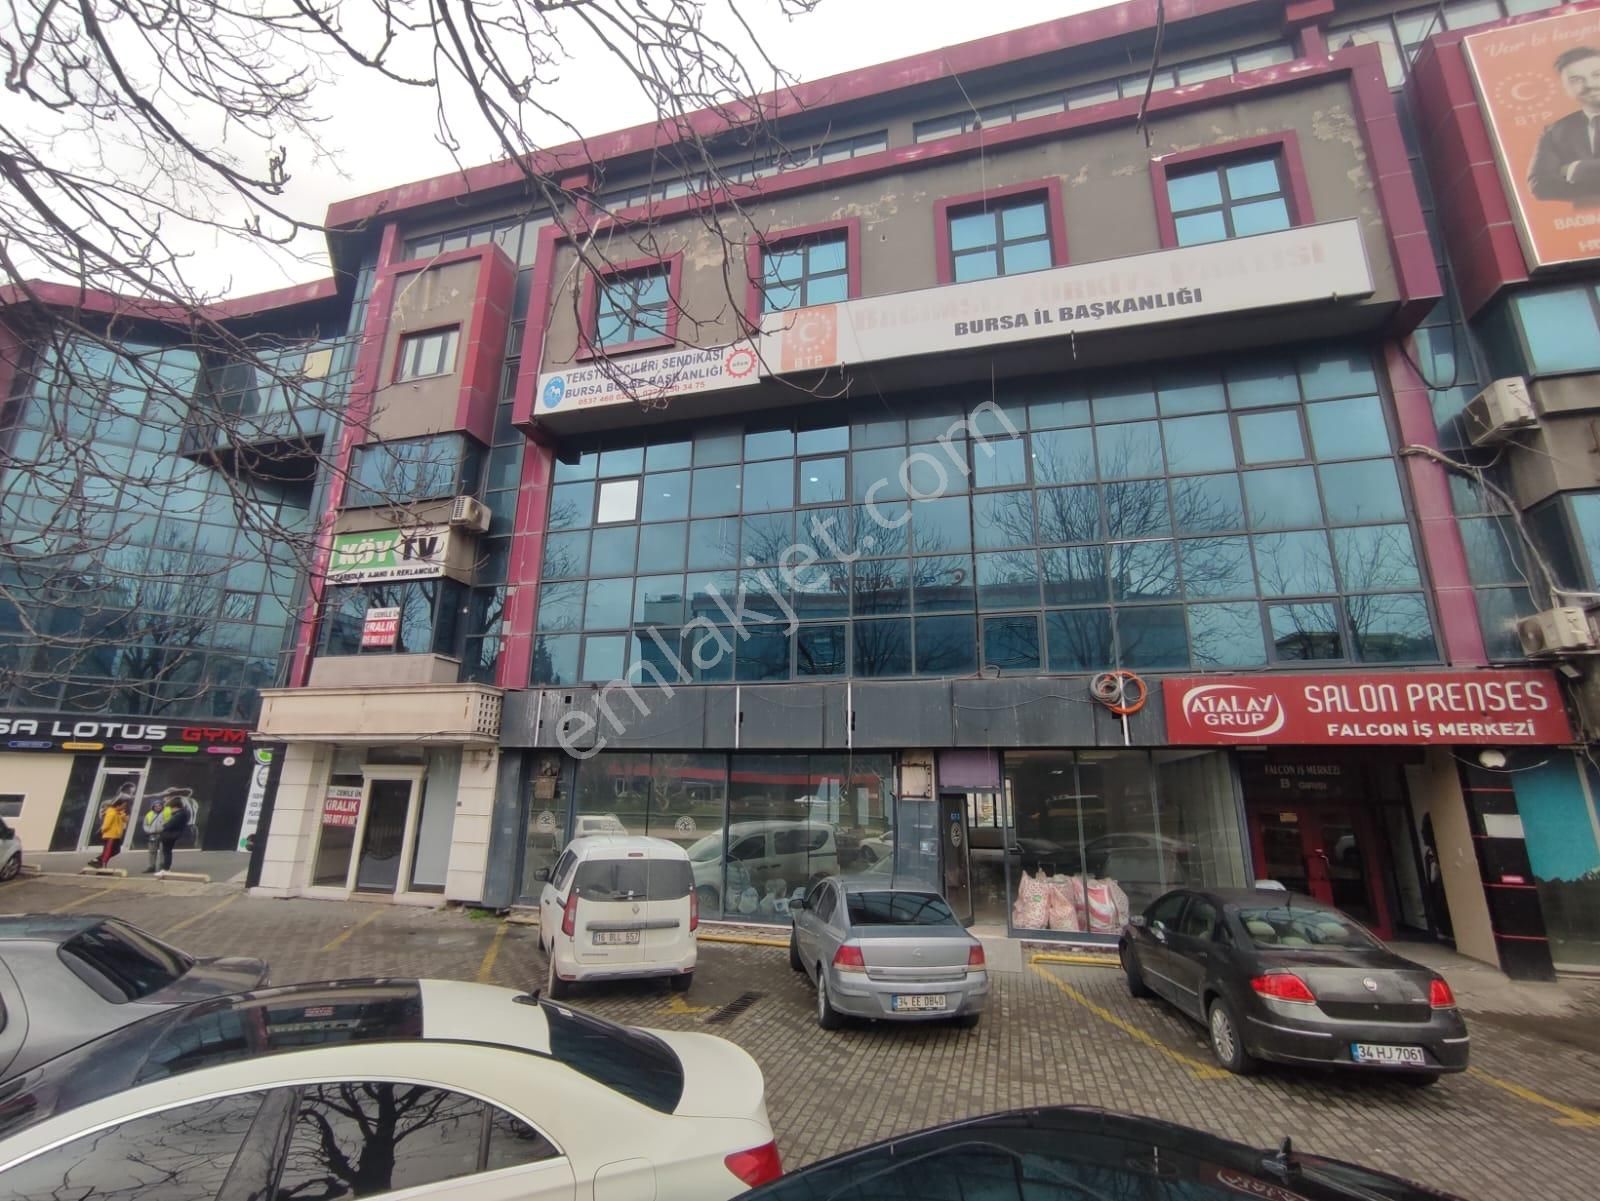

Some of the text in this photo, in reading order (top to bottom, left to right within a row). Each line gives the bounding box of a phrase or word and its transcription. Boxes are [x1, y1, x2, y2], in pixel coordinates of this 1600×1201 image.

[1514, 111, 1553, 127] BTP
[954, 287, 1203, 337] BURSA İL BAŞKANLIĞI
[565, 385, 603, 399] BURSA
[649, 366, 723, 385] BAŞKANLIĞI
[338, 536, 438, 565] KÖY TV
[396, 566, 440, 577] REKLAMCILIK
[1191, 694, 1273, 713] ATALAY
[1305, 680, 1549, 713] SALON PRENSES
[1204, 713, 1265, 726] GRUP
[1327, 718, 1535, 738] FALCON İŞ MERKEZİ
[51, 721, 168, 740] LOTUS
[182, 727, 248, 743] GYM
[1264, 764, 1295, 775] FALCON
[897, 995, 908, 1006] 34
[911, 995, 922, 1006] EE
[1358, 1046, 1424, 1060] 34 HJ 7061
